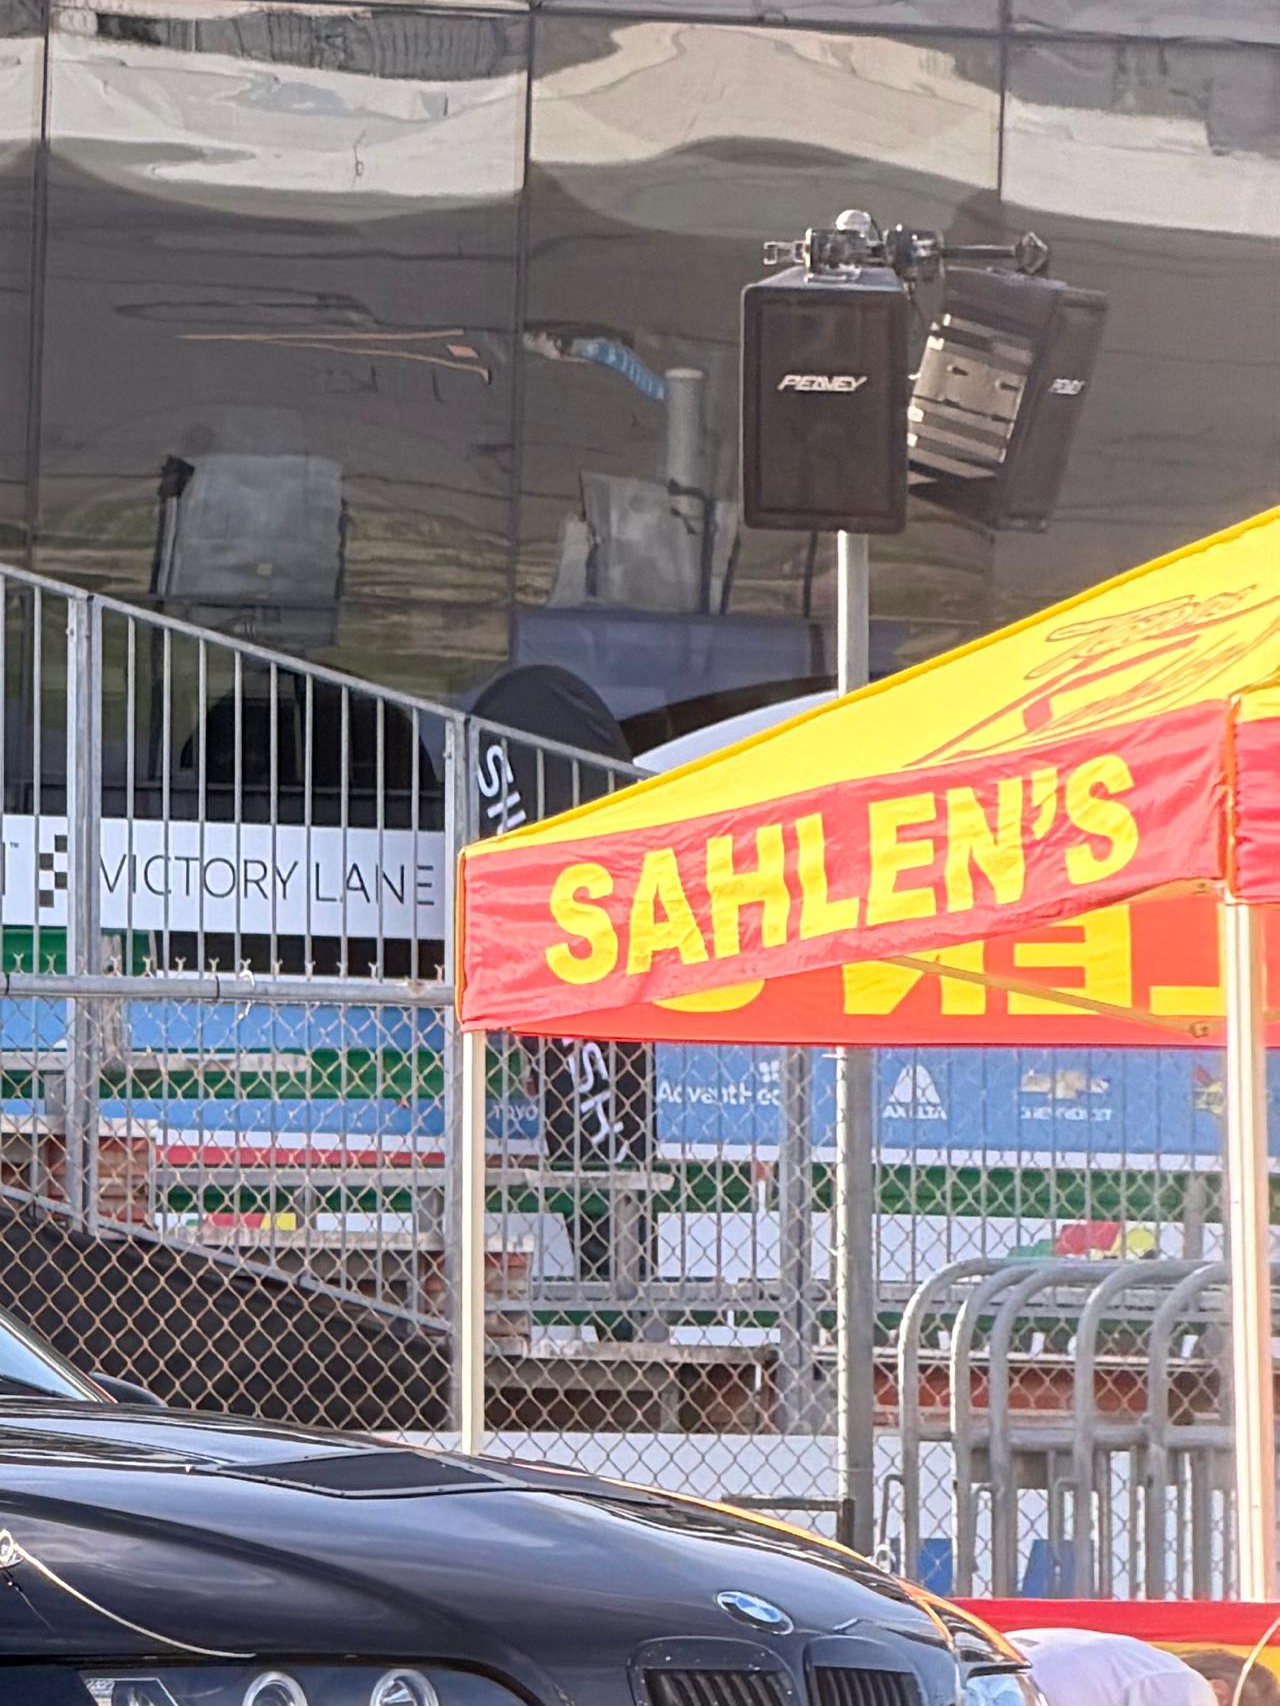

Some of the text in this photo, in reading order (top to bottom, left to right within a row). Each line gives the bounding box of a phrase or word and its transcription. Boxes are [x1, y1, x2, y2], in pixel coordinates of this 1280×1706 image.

[778, 374, 868, 392] PEAVEY
[100, 852, 436, 907] VICTORY LANE
[543, 754, 1139, 985] SAHLEN'S
